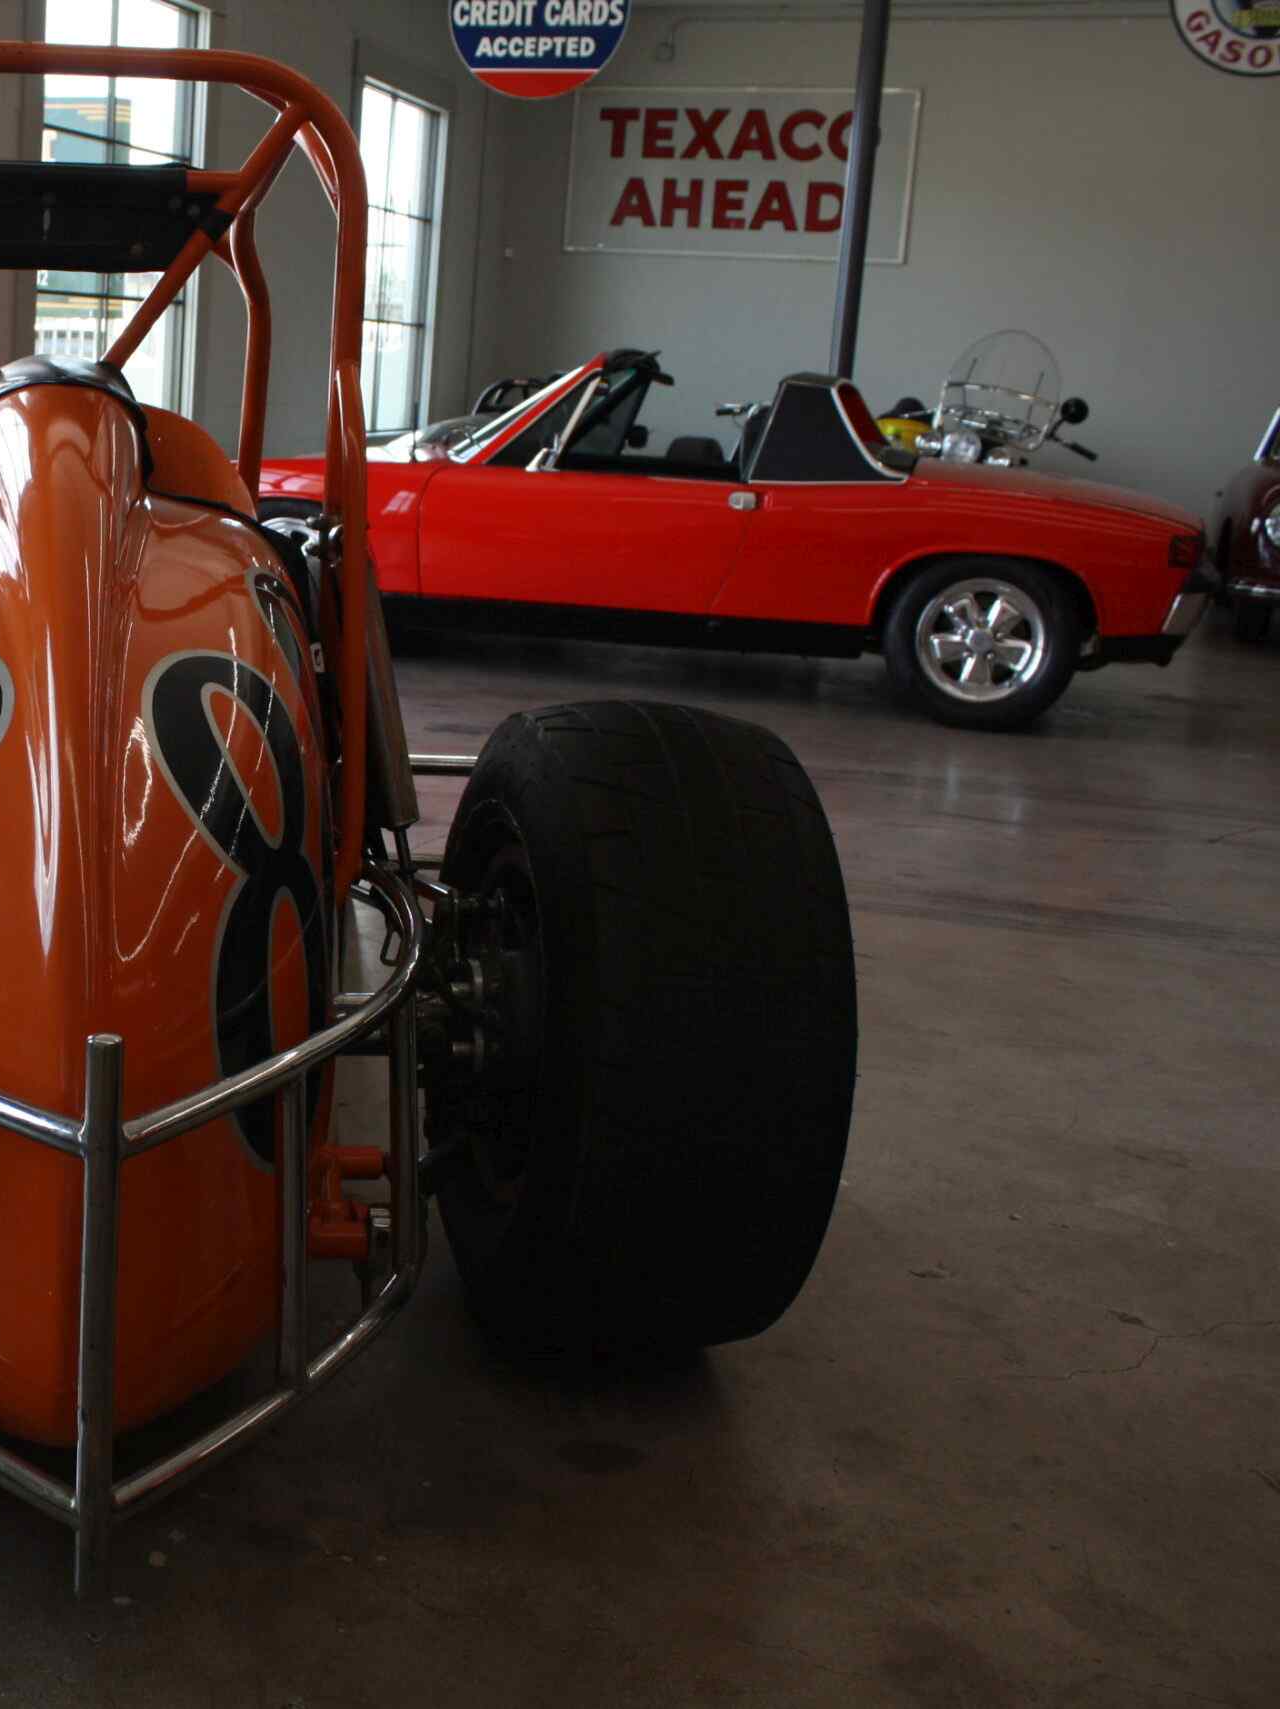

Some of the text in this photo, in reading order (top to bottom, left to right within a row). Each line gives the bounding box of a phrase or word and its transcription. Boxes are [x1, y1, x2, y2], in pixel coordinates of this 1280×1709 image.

[453, 0, 624, 26] CREDIT CARDS
[475, 36, 596, 57] ACCEPTED
[1185, 10, 1280, 69] GASO
[609, 177, 844, 232] AHEAD
